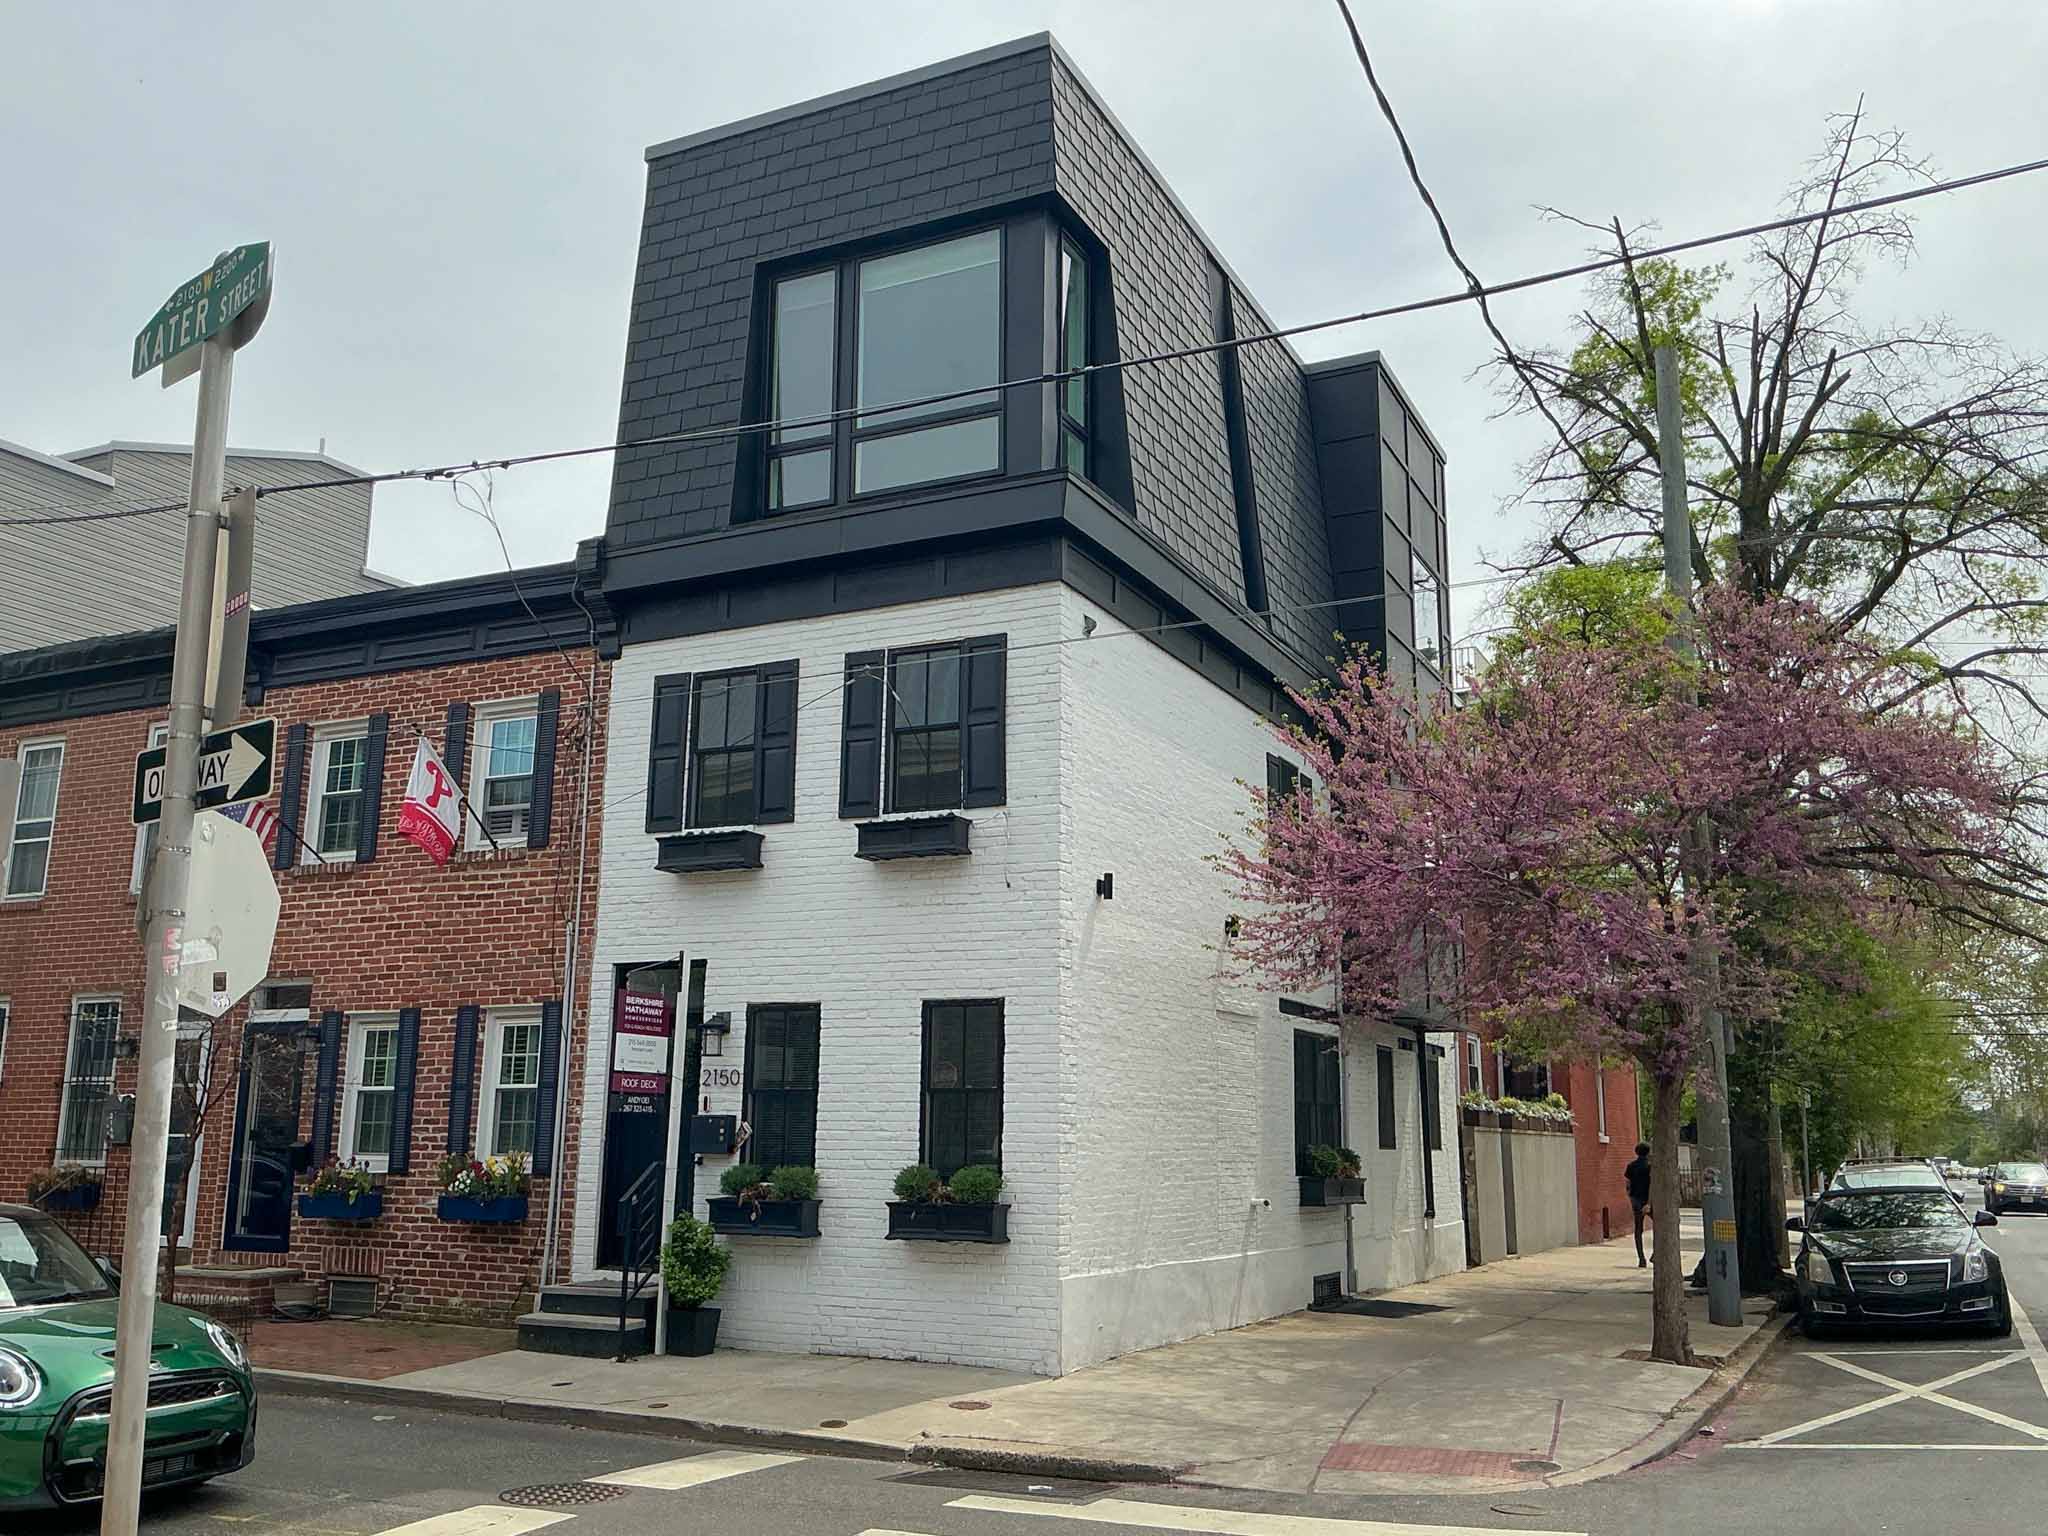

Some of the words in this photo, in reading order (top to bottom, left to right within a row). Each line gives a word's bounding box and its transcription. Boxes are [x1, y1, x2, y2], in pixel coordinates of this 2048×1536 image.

[138, 298, 209, 371] KATER
[219, 261, 264, 323] STREET
[626, 995, 664, 1008] BERKSHIRE
[625, 1005, 664, 1016] HATHAWAY
[622, 1078, 639, 1088] ROOF
[640, 1079, 657, 1088] DECK
[702, 1069, 740, 1086] 2150
